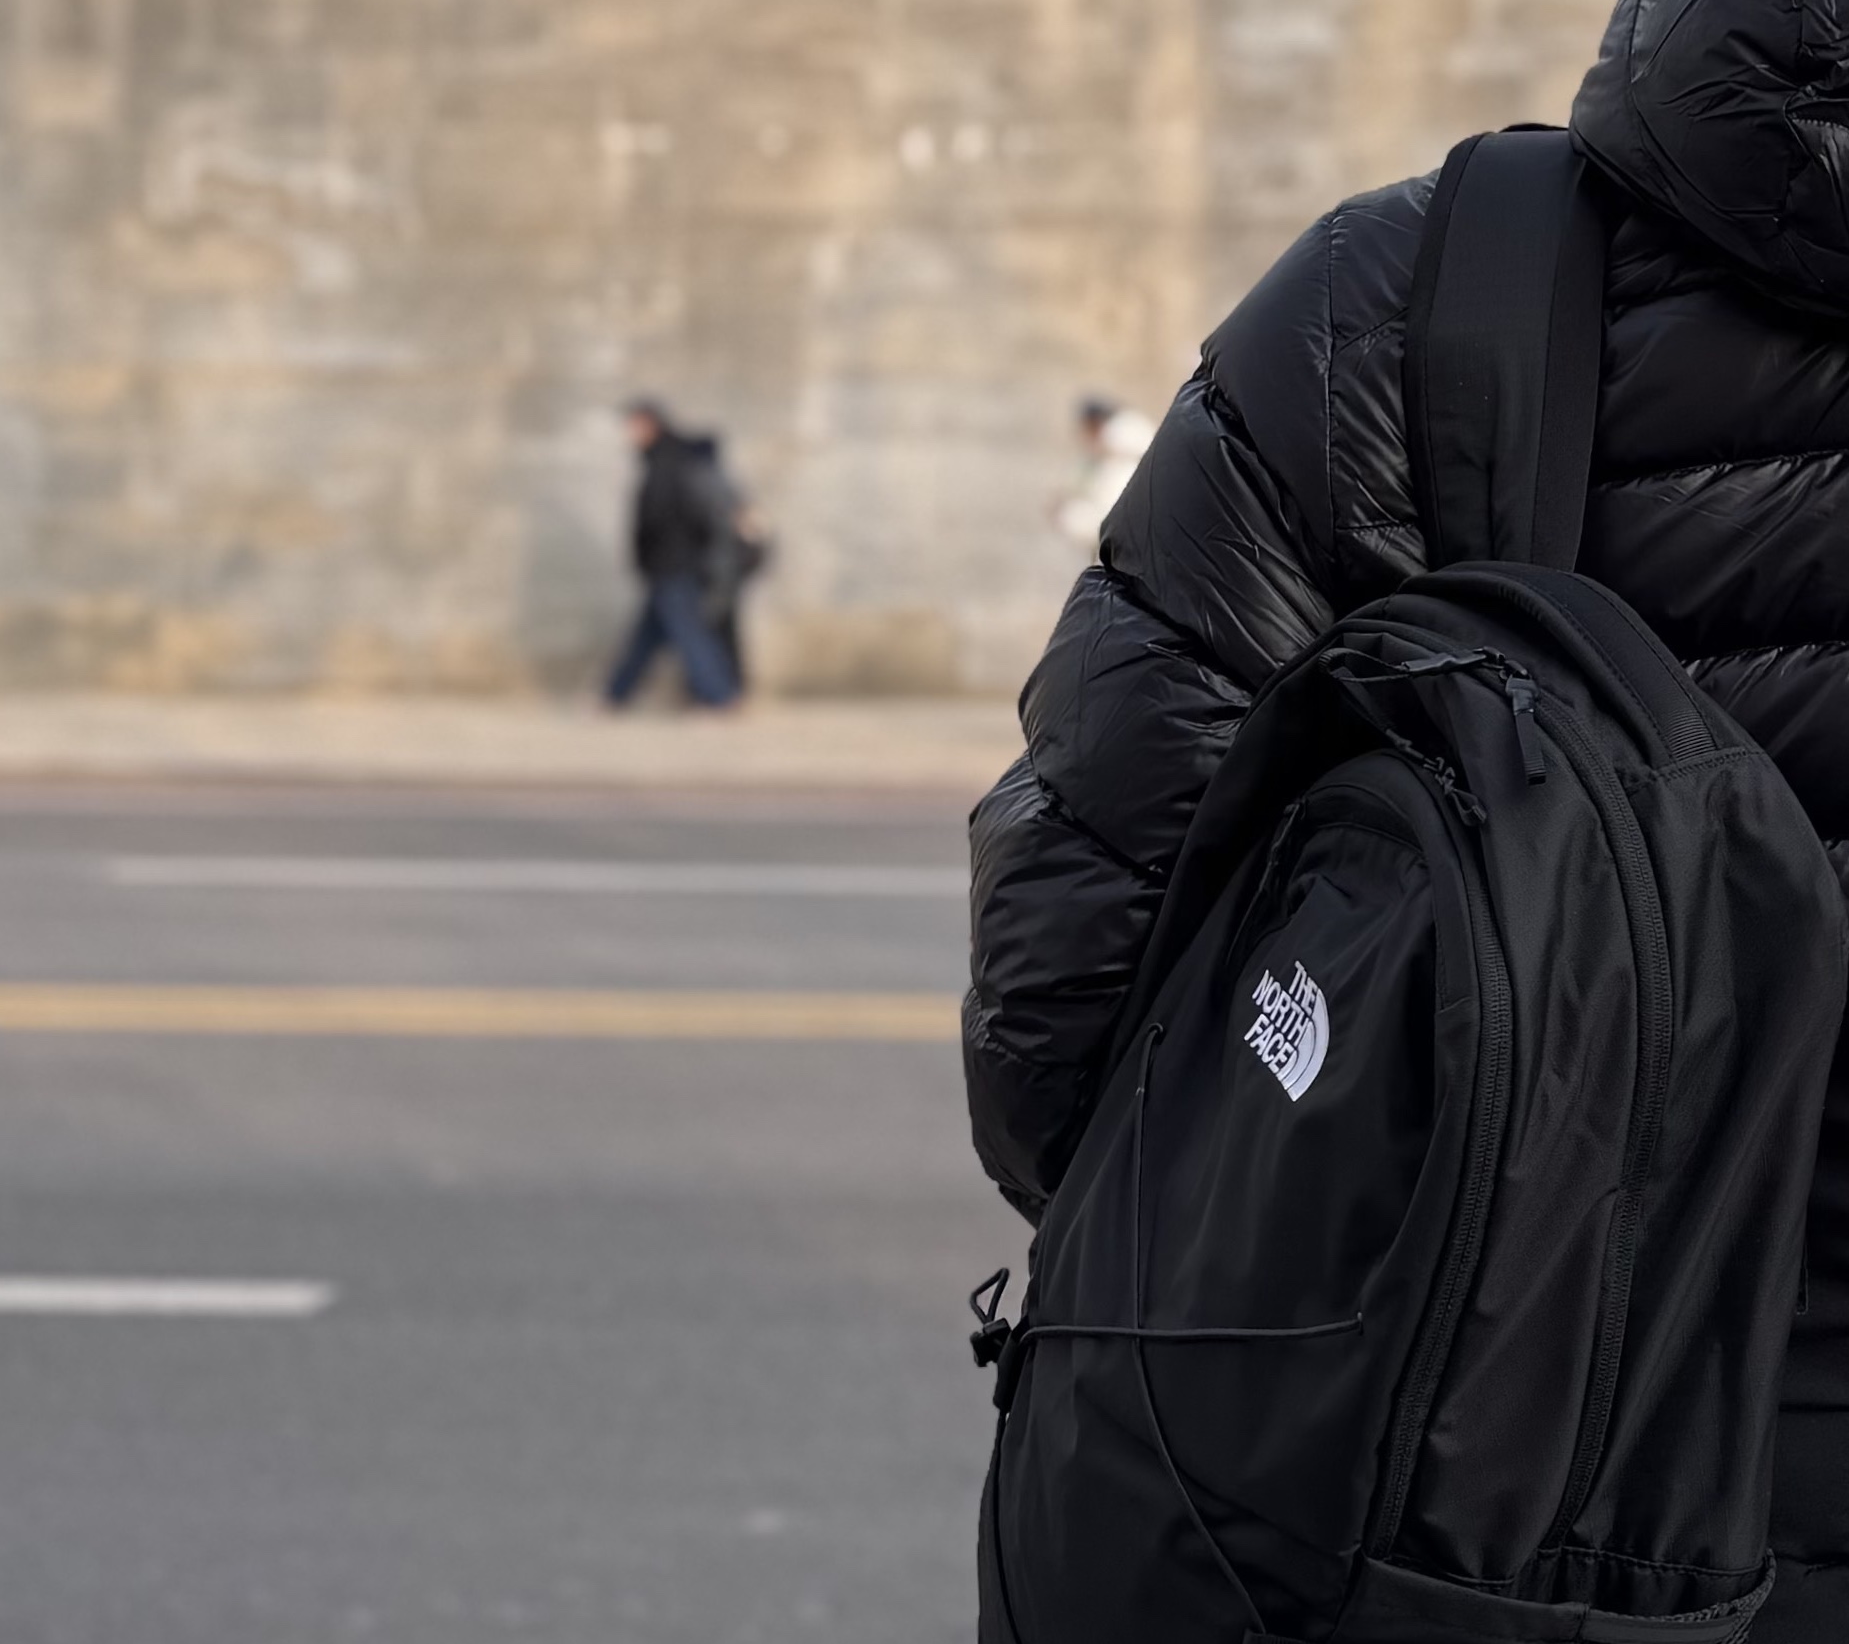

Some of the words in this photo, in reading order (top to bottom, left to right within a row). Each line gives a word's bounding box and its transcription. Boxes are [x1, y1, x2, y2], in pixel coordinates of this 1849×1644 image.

[1252, 969, 1309, 1046] NORTH
[1288, 960, 1318, 1016] THE
[1243, 1013, 1296, 1074] FACE
